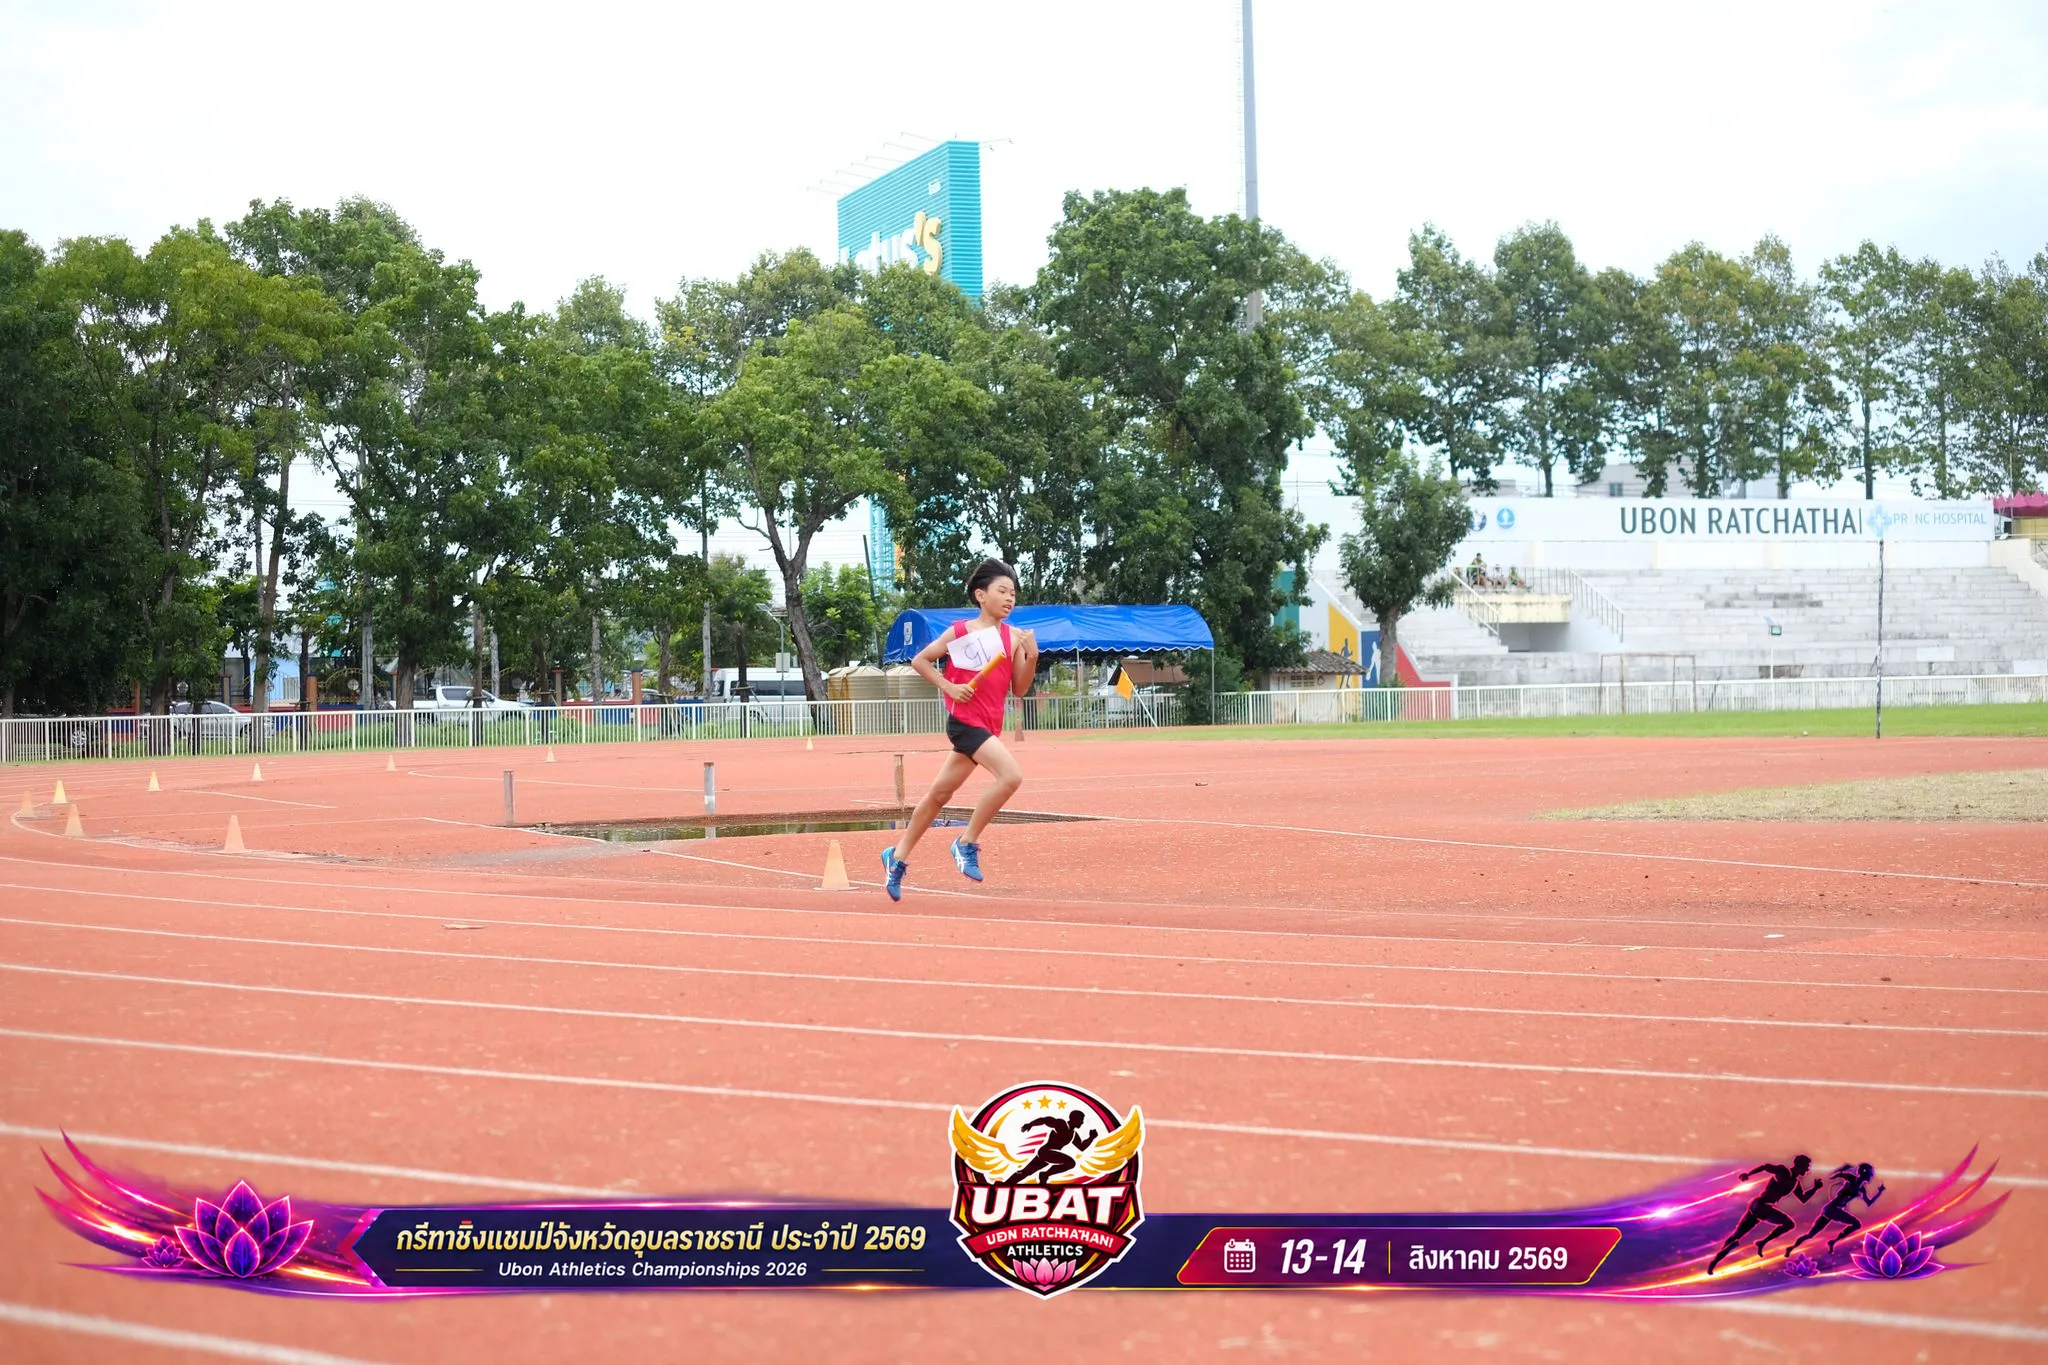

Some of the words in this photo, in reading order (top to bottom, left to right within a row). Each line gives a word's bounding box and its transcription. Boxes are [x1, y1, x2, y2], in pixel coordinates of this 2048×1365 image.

[1620, 507, 1696, 534] UBON
[1707, 507, 1863, 534] RATCHATHA
[1933, 512, 1988, 525] HOSPITAL
